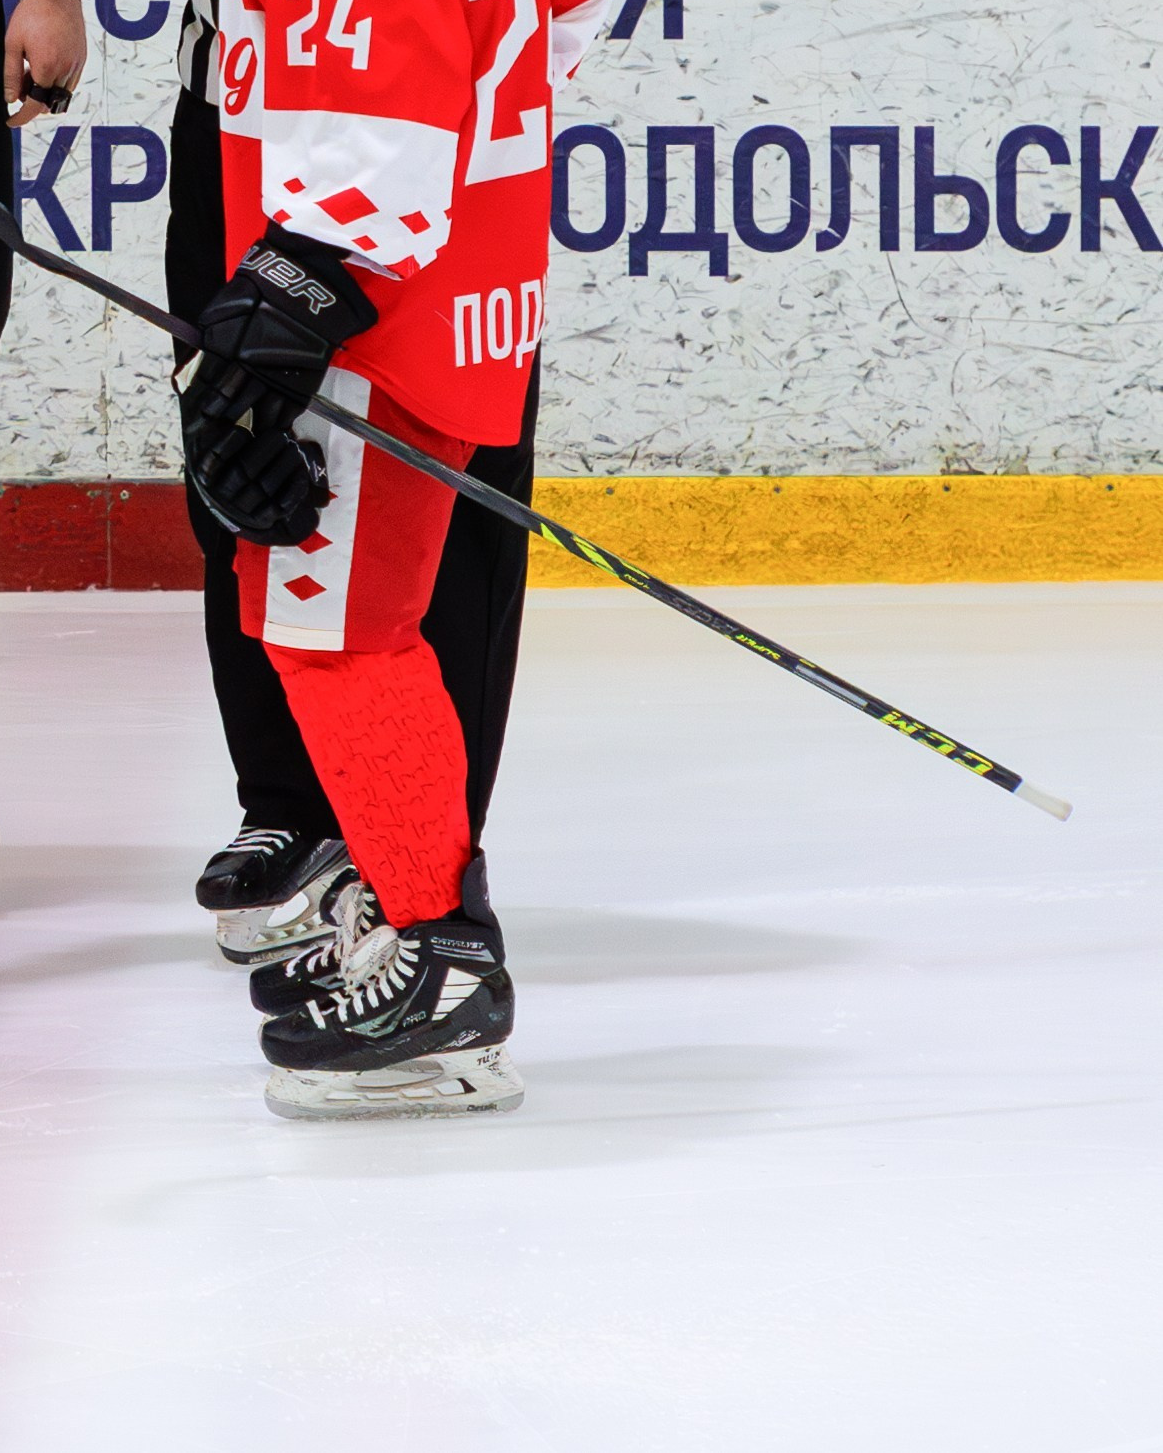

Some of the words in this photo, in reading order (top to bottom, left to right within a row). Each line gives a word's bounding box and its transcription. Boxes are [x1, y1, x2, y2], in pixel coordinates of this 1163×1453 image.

[12, 126, 167, 252] КР
[550, 124, 1163, 277] ОДОЛЬСК
[238, 245, 337, 315] UER
[454, 274, 546, 369] ПОД
[879, 711, 994, 776] CCM
